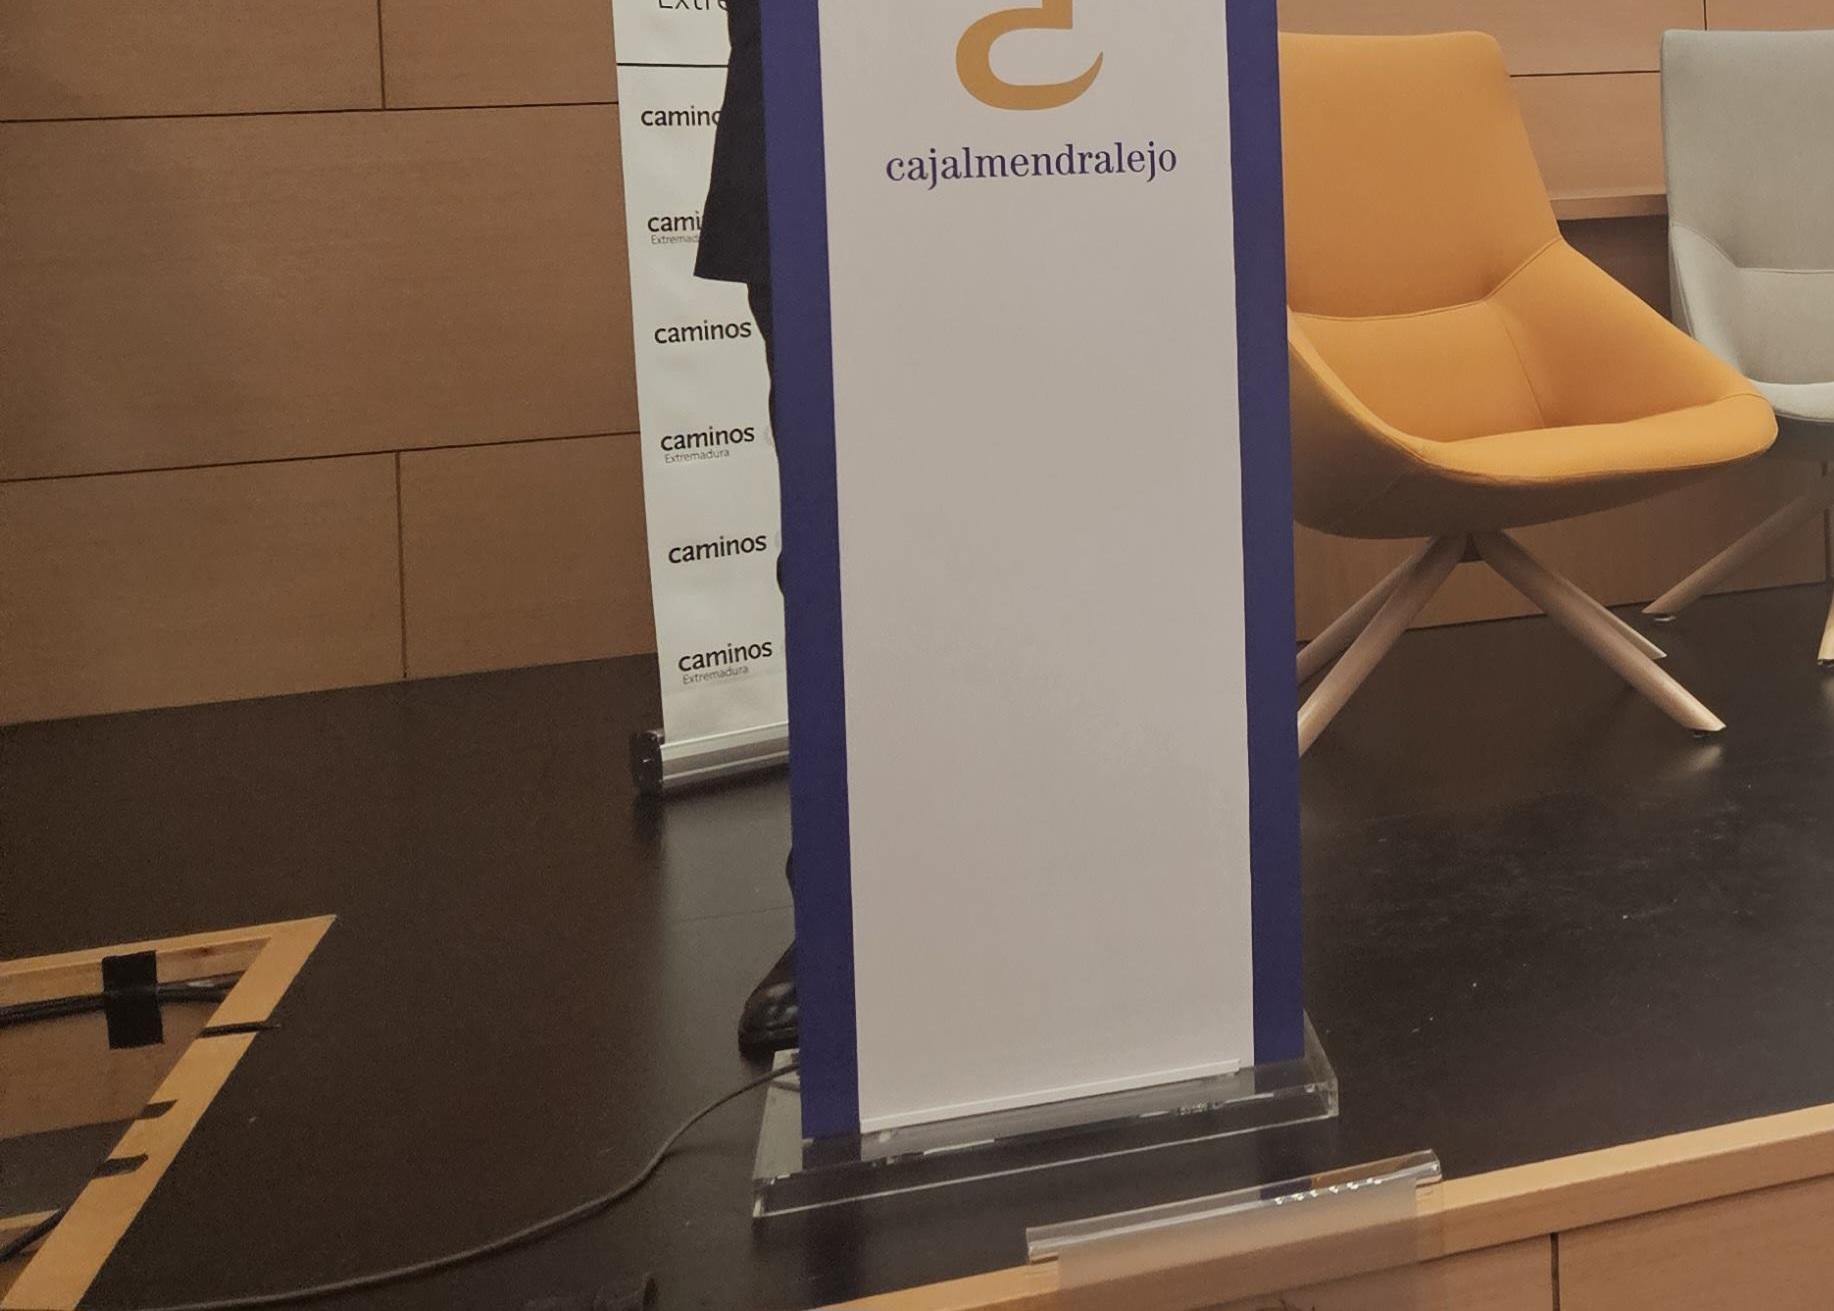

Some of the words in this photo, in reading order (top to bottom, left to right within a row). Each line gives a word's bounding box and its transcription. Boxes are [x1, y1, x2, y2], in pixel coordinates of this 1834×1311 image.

[886, 141, 1177, 190] cajalmendralejo
[648, 211, 702, 232] cami
[655, 320, 752, 344] caminos
[661, 426, 755, 451] caminos
[664, 449, 730, 464] Extremadura
[668, 535, 767, 563] caminos
[678, 642, 773, 672] caminos
[683, 666, 749, 685] Extremadura
